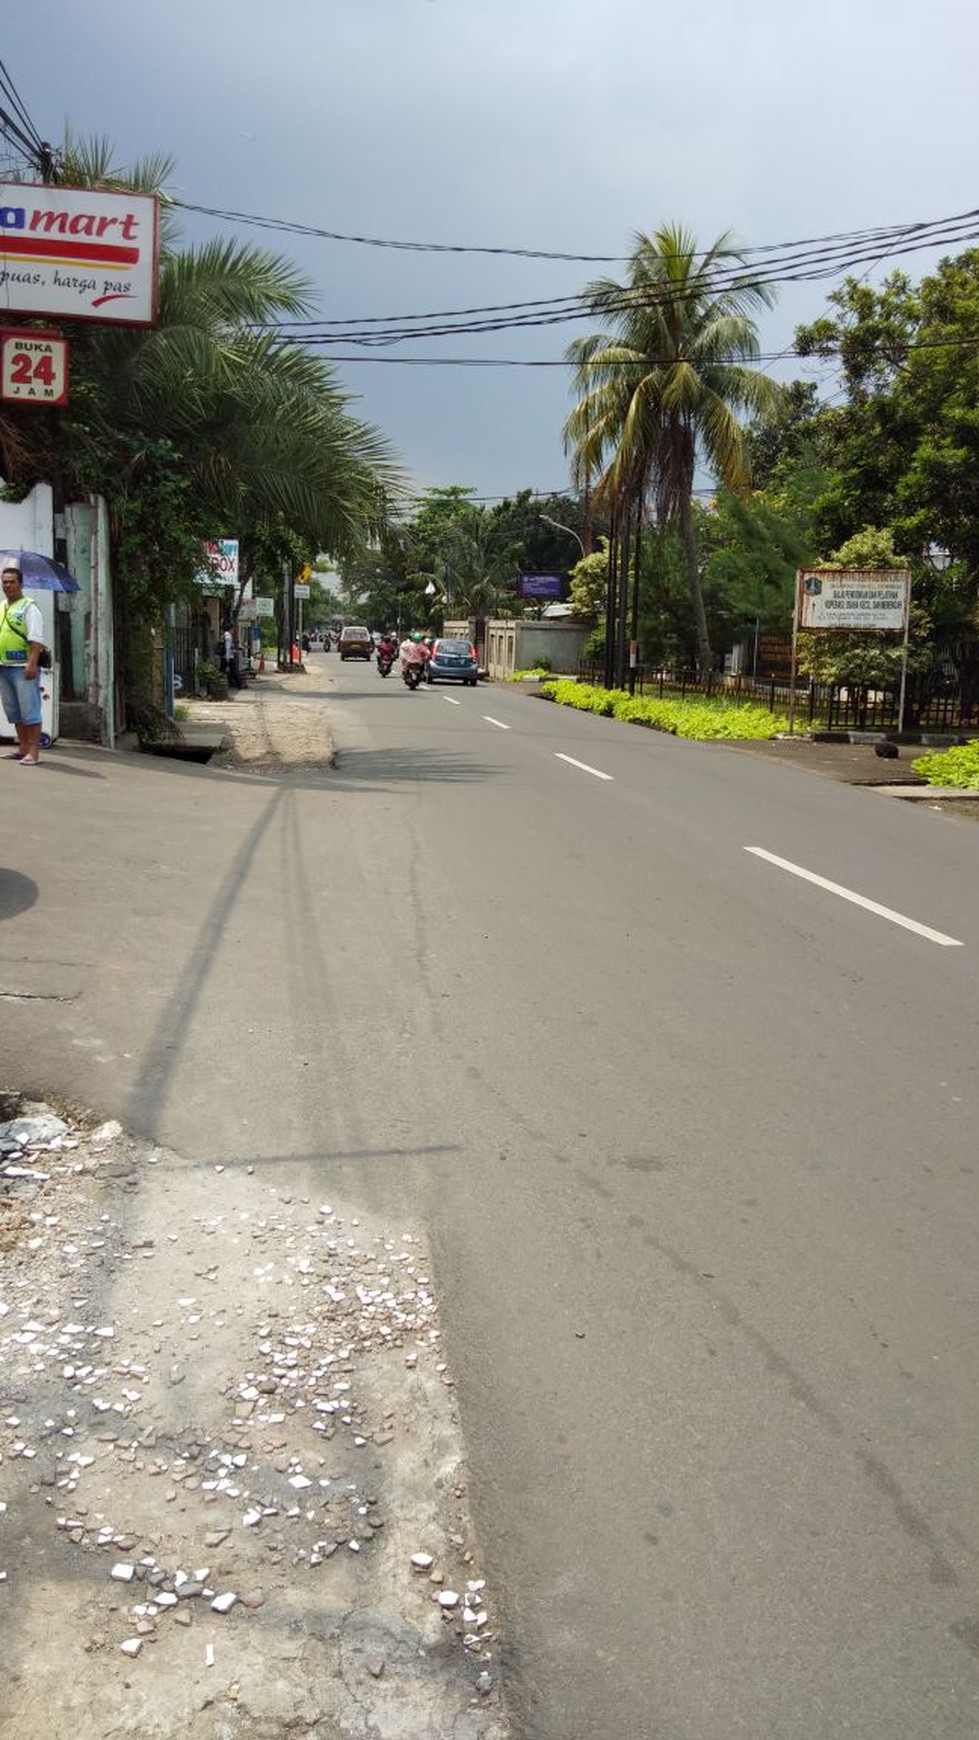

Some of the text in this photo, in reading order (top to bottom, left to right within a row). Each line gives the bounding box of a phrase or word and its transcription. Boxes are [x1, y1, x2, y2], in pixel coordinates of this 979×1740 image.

[54, 269, 96, 294] harga
[103, 280, 131, 296] pas
[15, 342, 53, 352] BUKA
[9, 353, 56, 386] 24
